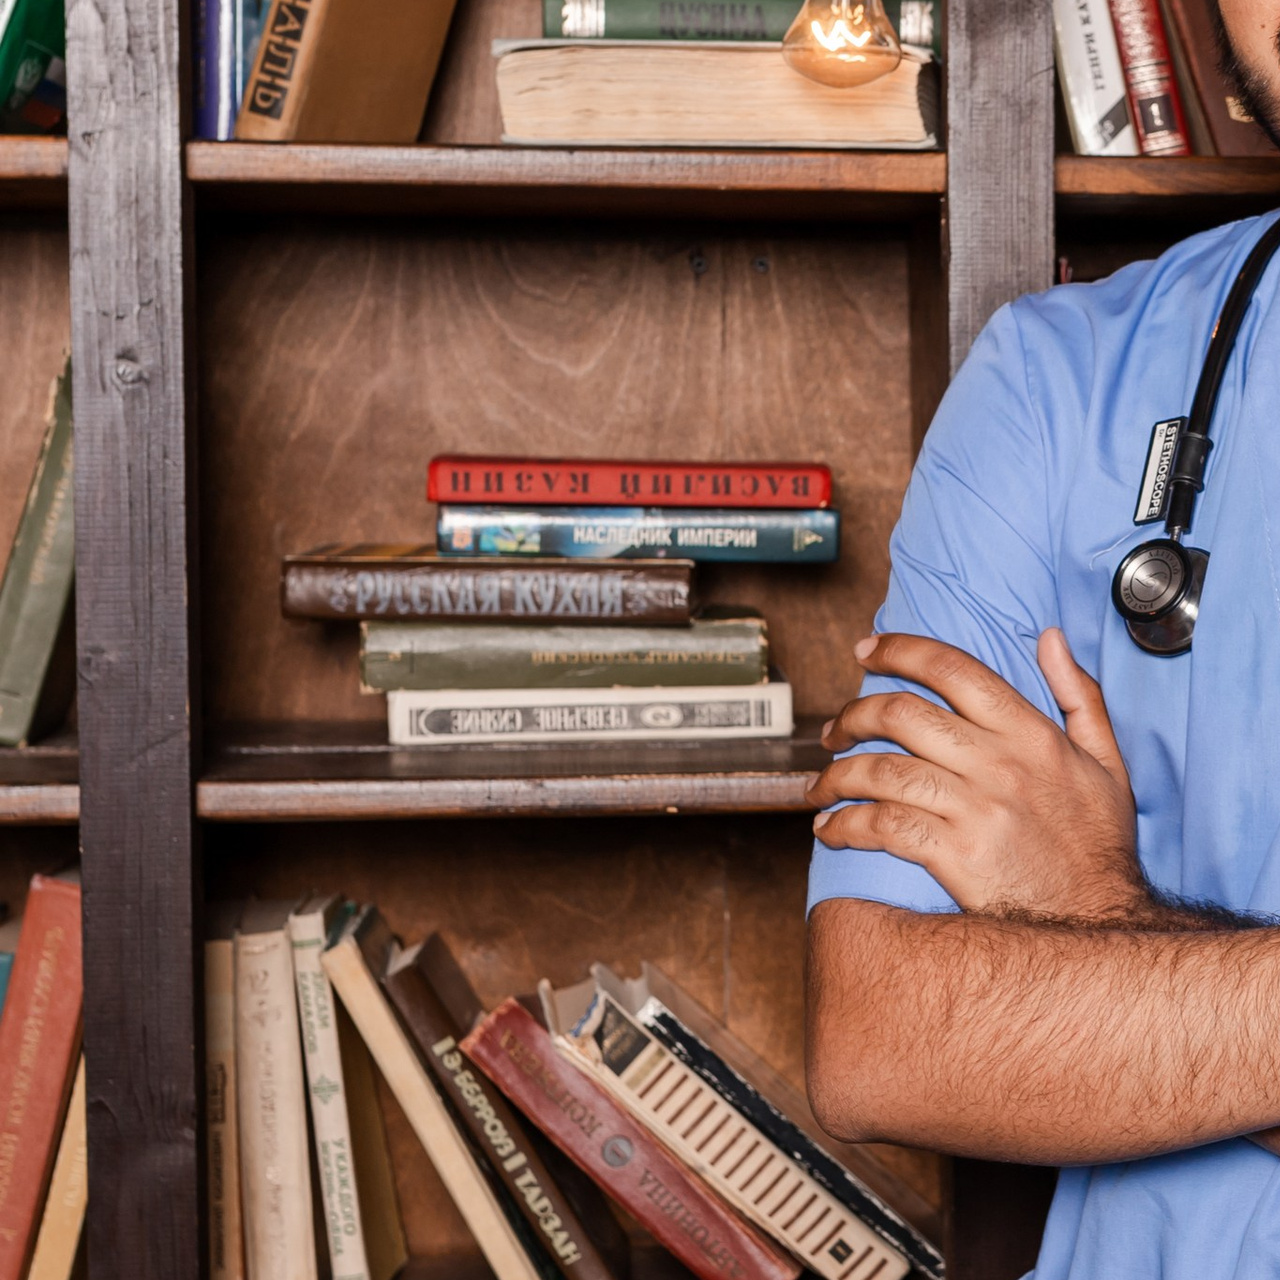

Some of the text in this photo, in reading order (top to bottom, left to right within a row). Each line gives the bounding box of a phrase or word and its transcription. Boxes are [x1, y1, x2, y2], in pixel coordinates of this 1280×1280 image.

[1081, 30, 1107, 92] ГЕНРИ
[450, 469, 810, 502] ВАСИЛИЙ КАЗИН
[1147, 425, 1177, 517] STETHOSCOPE
[573, 524, 757, 547] НАСЛЕДНИК ИМПЕРИИ
[355, 570, 623, 618] РУССКАЯ КУХНЯ
[333, 1152, 356, 1236] КАЖДОГО
[511, 1166, 583, 1267] ТАРЗАН
